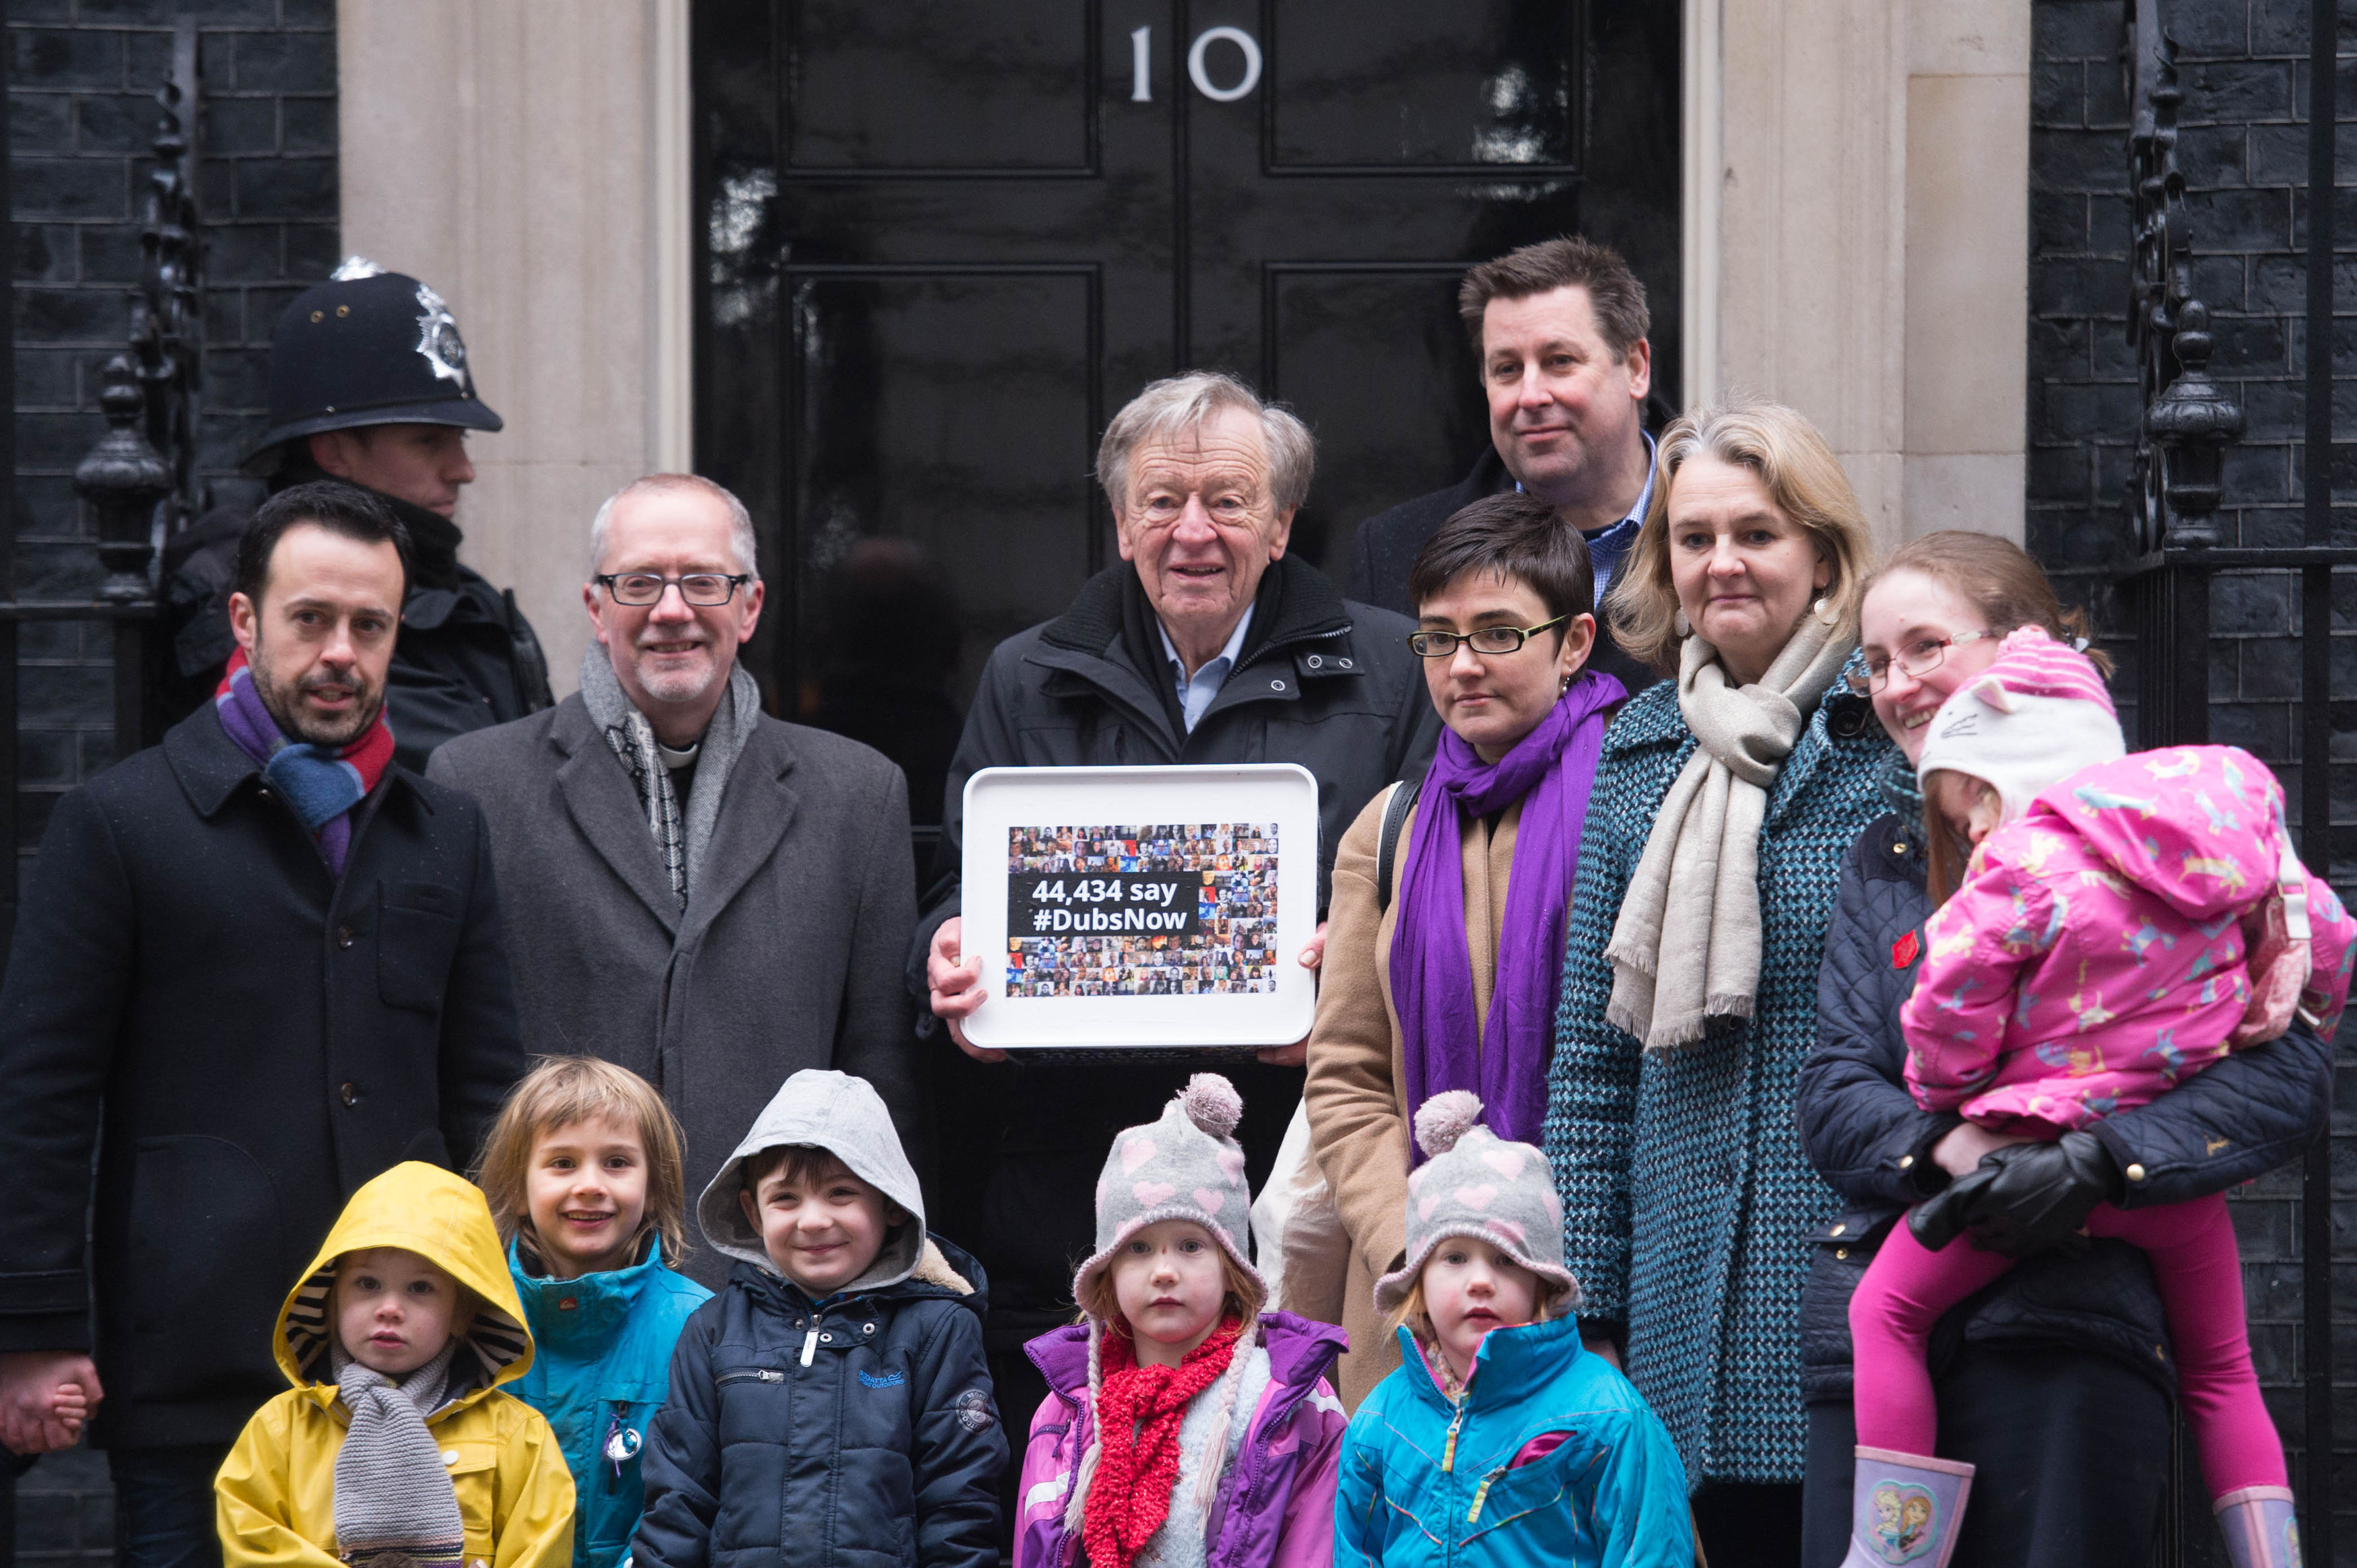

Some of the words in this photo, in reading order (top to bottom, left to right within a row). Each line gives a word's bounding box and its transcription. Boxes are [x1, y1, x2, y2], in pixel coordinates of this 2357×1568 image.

[1131, 26, 1263, 102] 10
[1032, 879, 1123, 906] 44,434
[1130, 883, 1178, 907] say
[1033, 908, 1187, 931] #DubsNow
